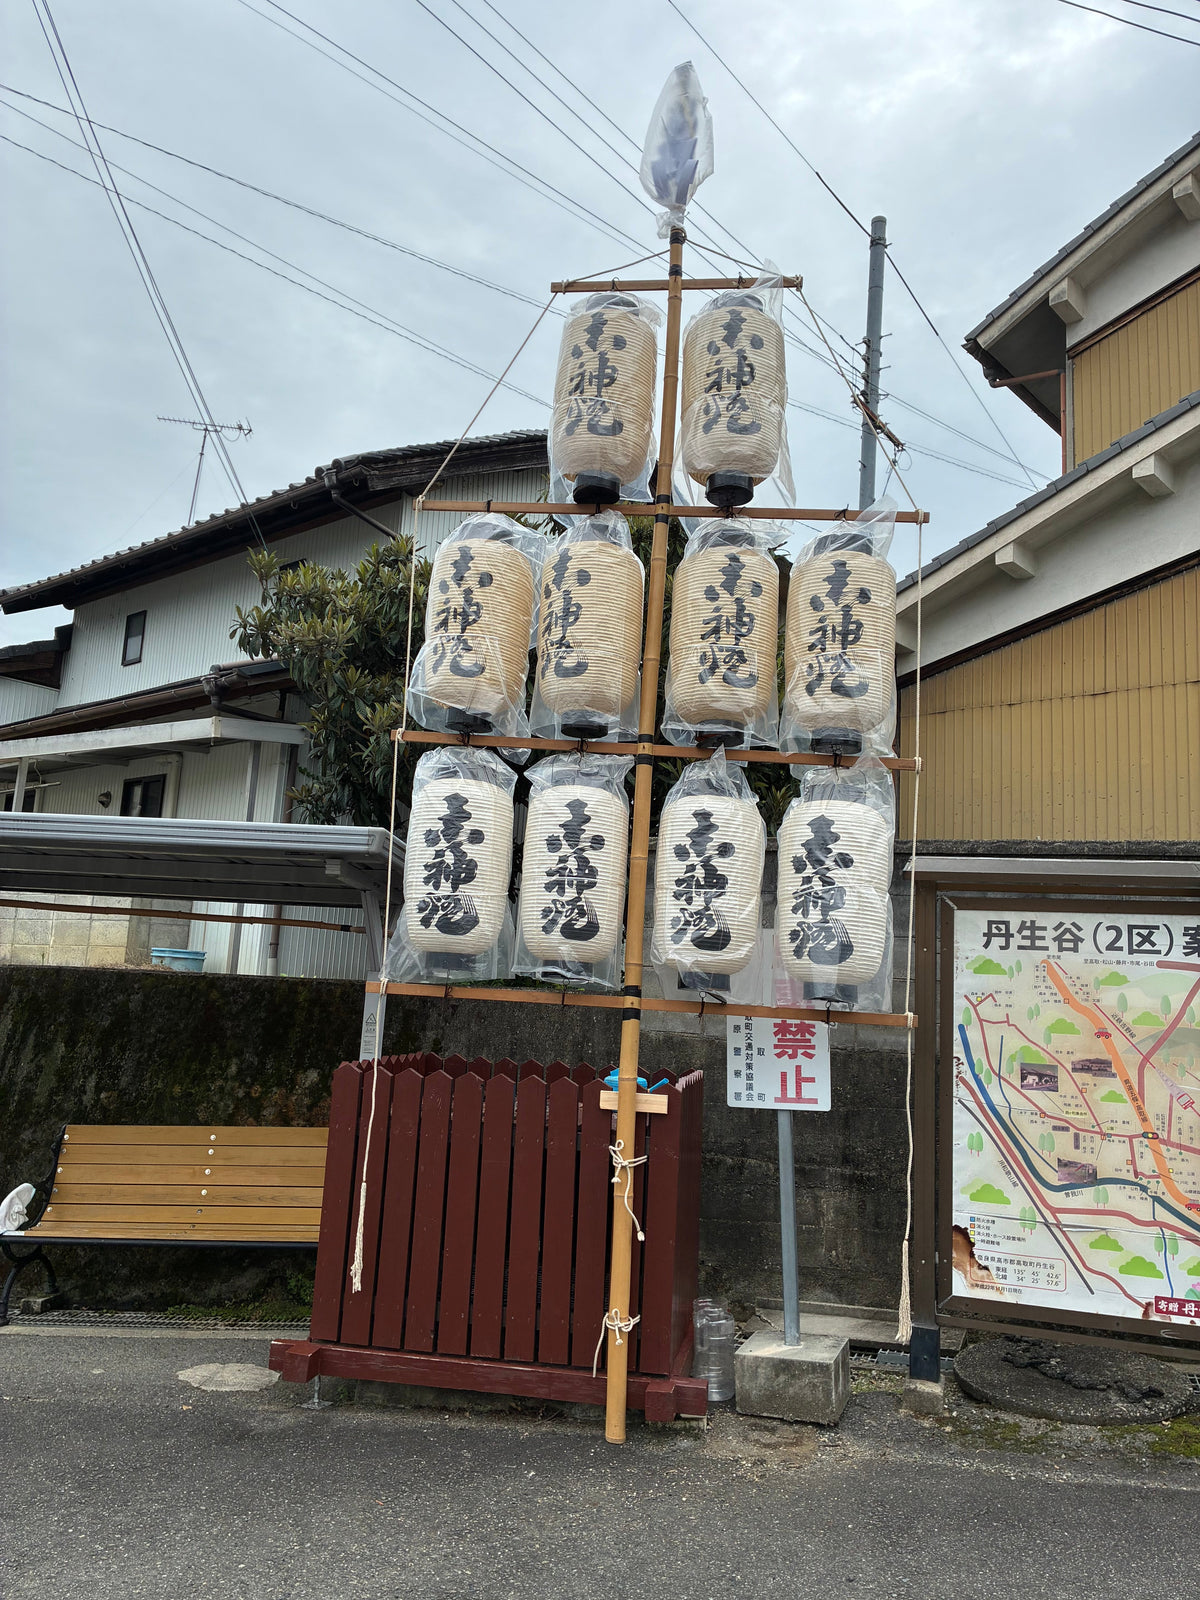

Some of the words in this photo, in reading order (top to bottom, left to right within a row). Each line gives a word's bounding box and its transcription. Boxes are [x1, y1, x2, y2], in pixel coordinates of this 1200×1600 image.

[977, 1254, 1055, 1271] 奈良県高市郡高取町丹生谷
[995, 1266, 1007, 1274] 東経
[995, 1272, 1007, 1280] 北緯
[1157, 1300, 1179, 1313] 寄贈
[1182, 1302, 1200, 1316] 丹
